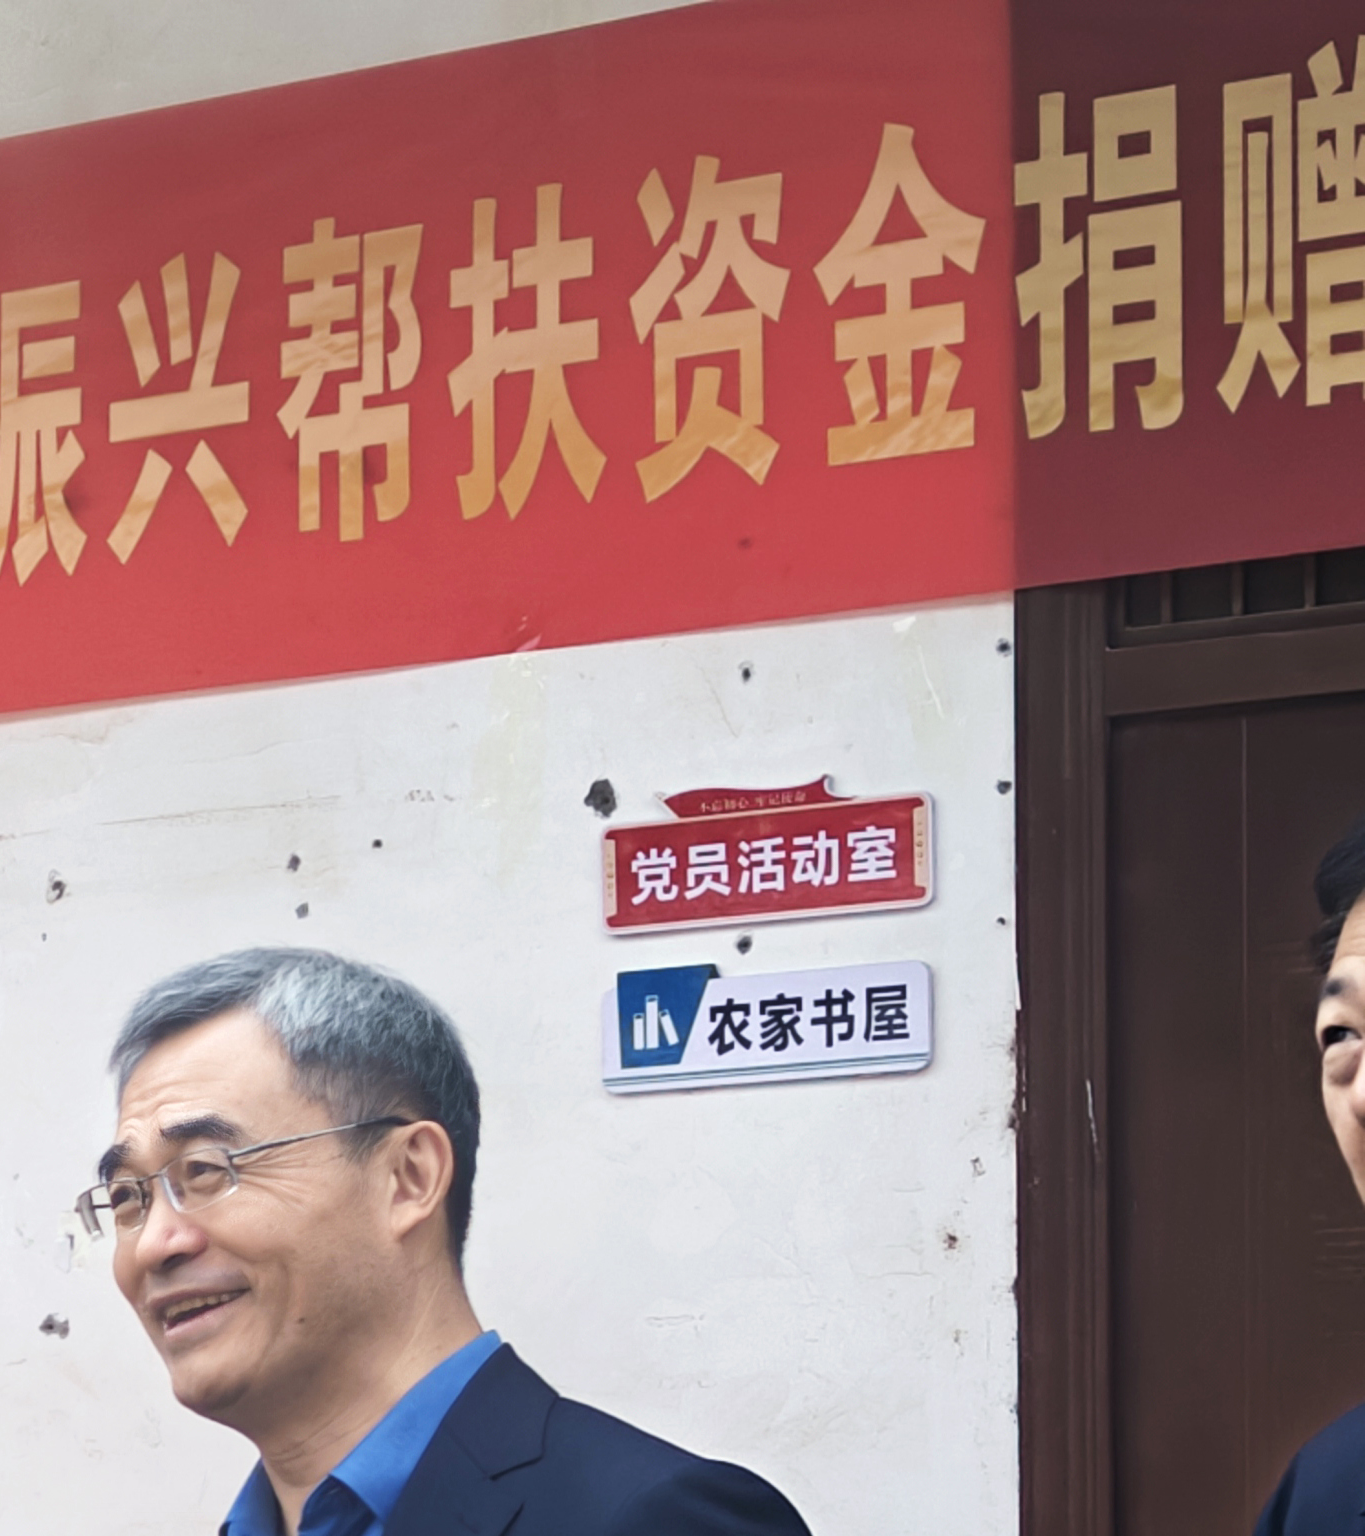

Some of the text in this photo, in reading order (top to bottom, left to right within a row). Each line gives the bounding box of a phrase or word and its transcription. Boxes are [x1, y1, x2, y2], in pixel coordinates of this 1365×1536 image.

[630, 825, 897, 906] 党员活动室
[707, 983, 911, 1056] 农家书屋
